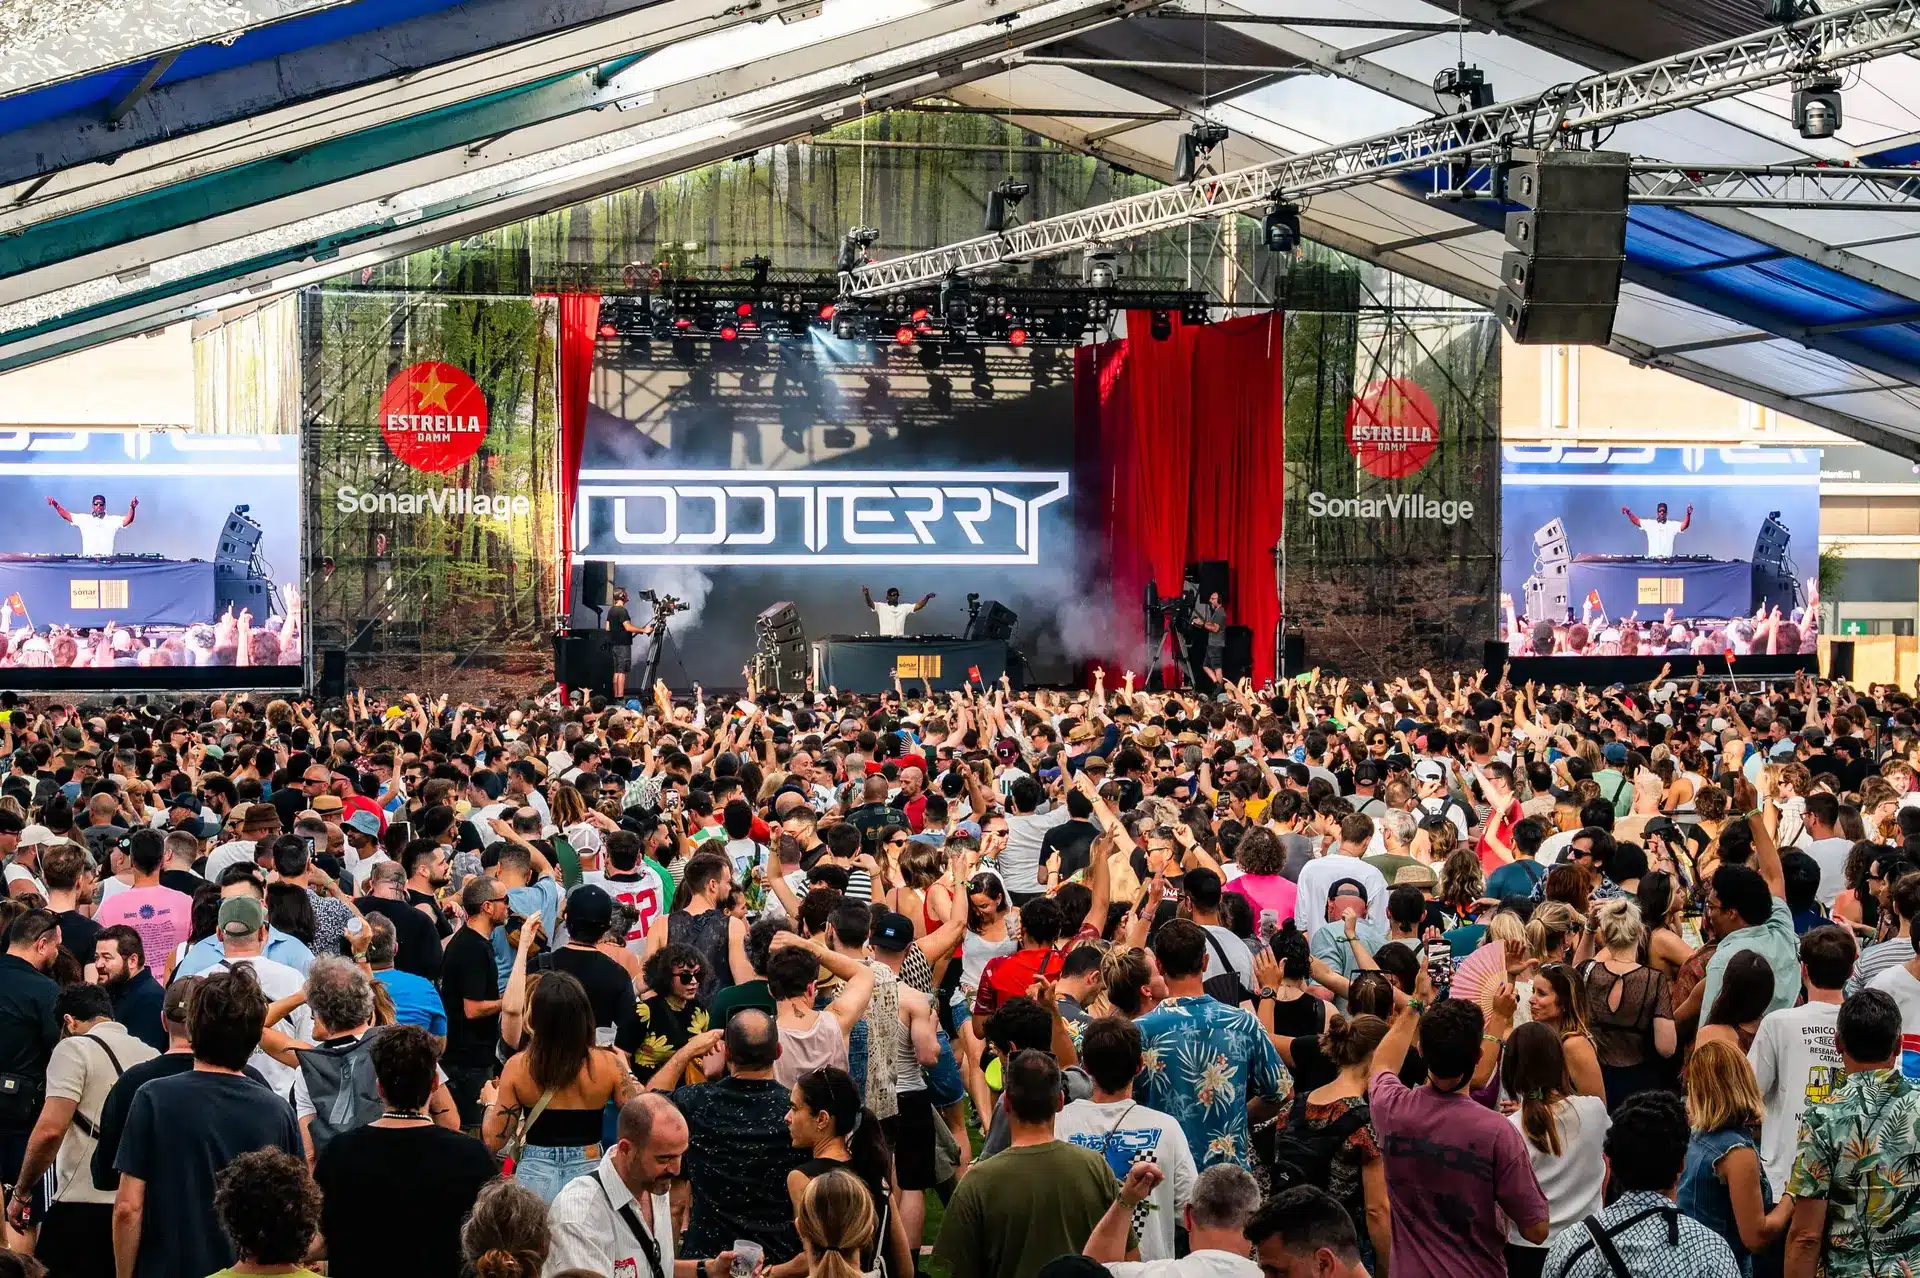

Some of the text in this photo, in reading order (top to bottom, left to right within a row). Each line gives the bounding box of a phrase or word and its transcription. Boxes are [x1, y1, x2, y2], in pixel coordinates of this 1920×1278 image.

[387, 414, 481, 432] ESTRELLA
[417, 433, 451, 442] DAMM
[1352, 426, 1432, 442] ESTRELLA
[1378, 443, 1407, 451] DAMM
[337, 486, 529, 521] SonarVillage
[1308, 492, 1474, 525] SonarVillage
[778, 475, 1068, 556] TERRY
[1802, 1026, 1836, 1035] ENRICO
[1810, 1046, 1842, 1057] RESEARC
[1819, 1054, 1843, 1063] CATALO
